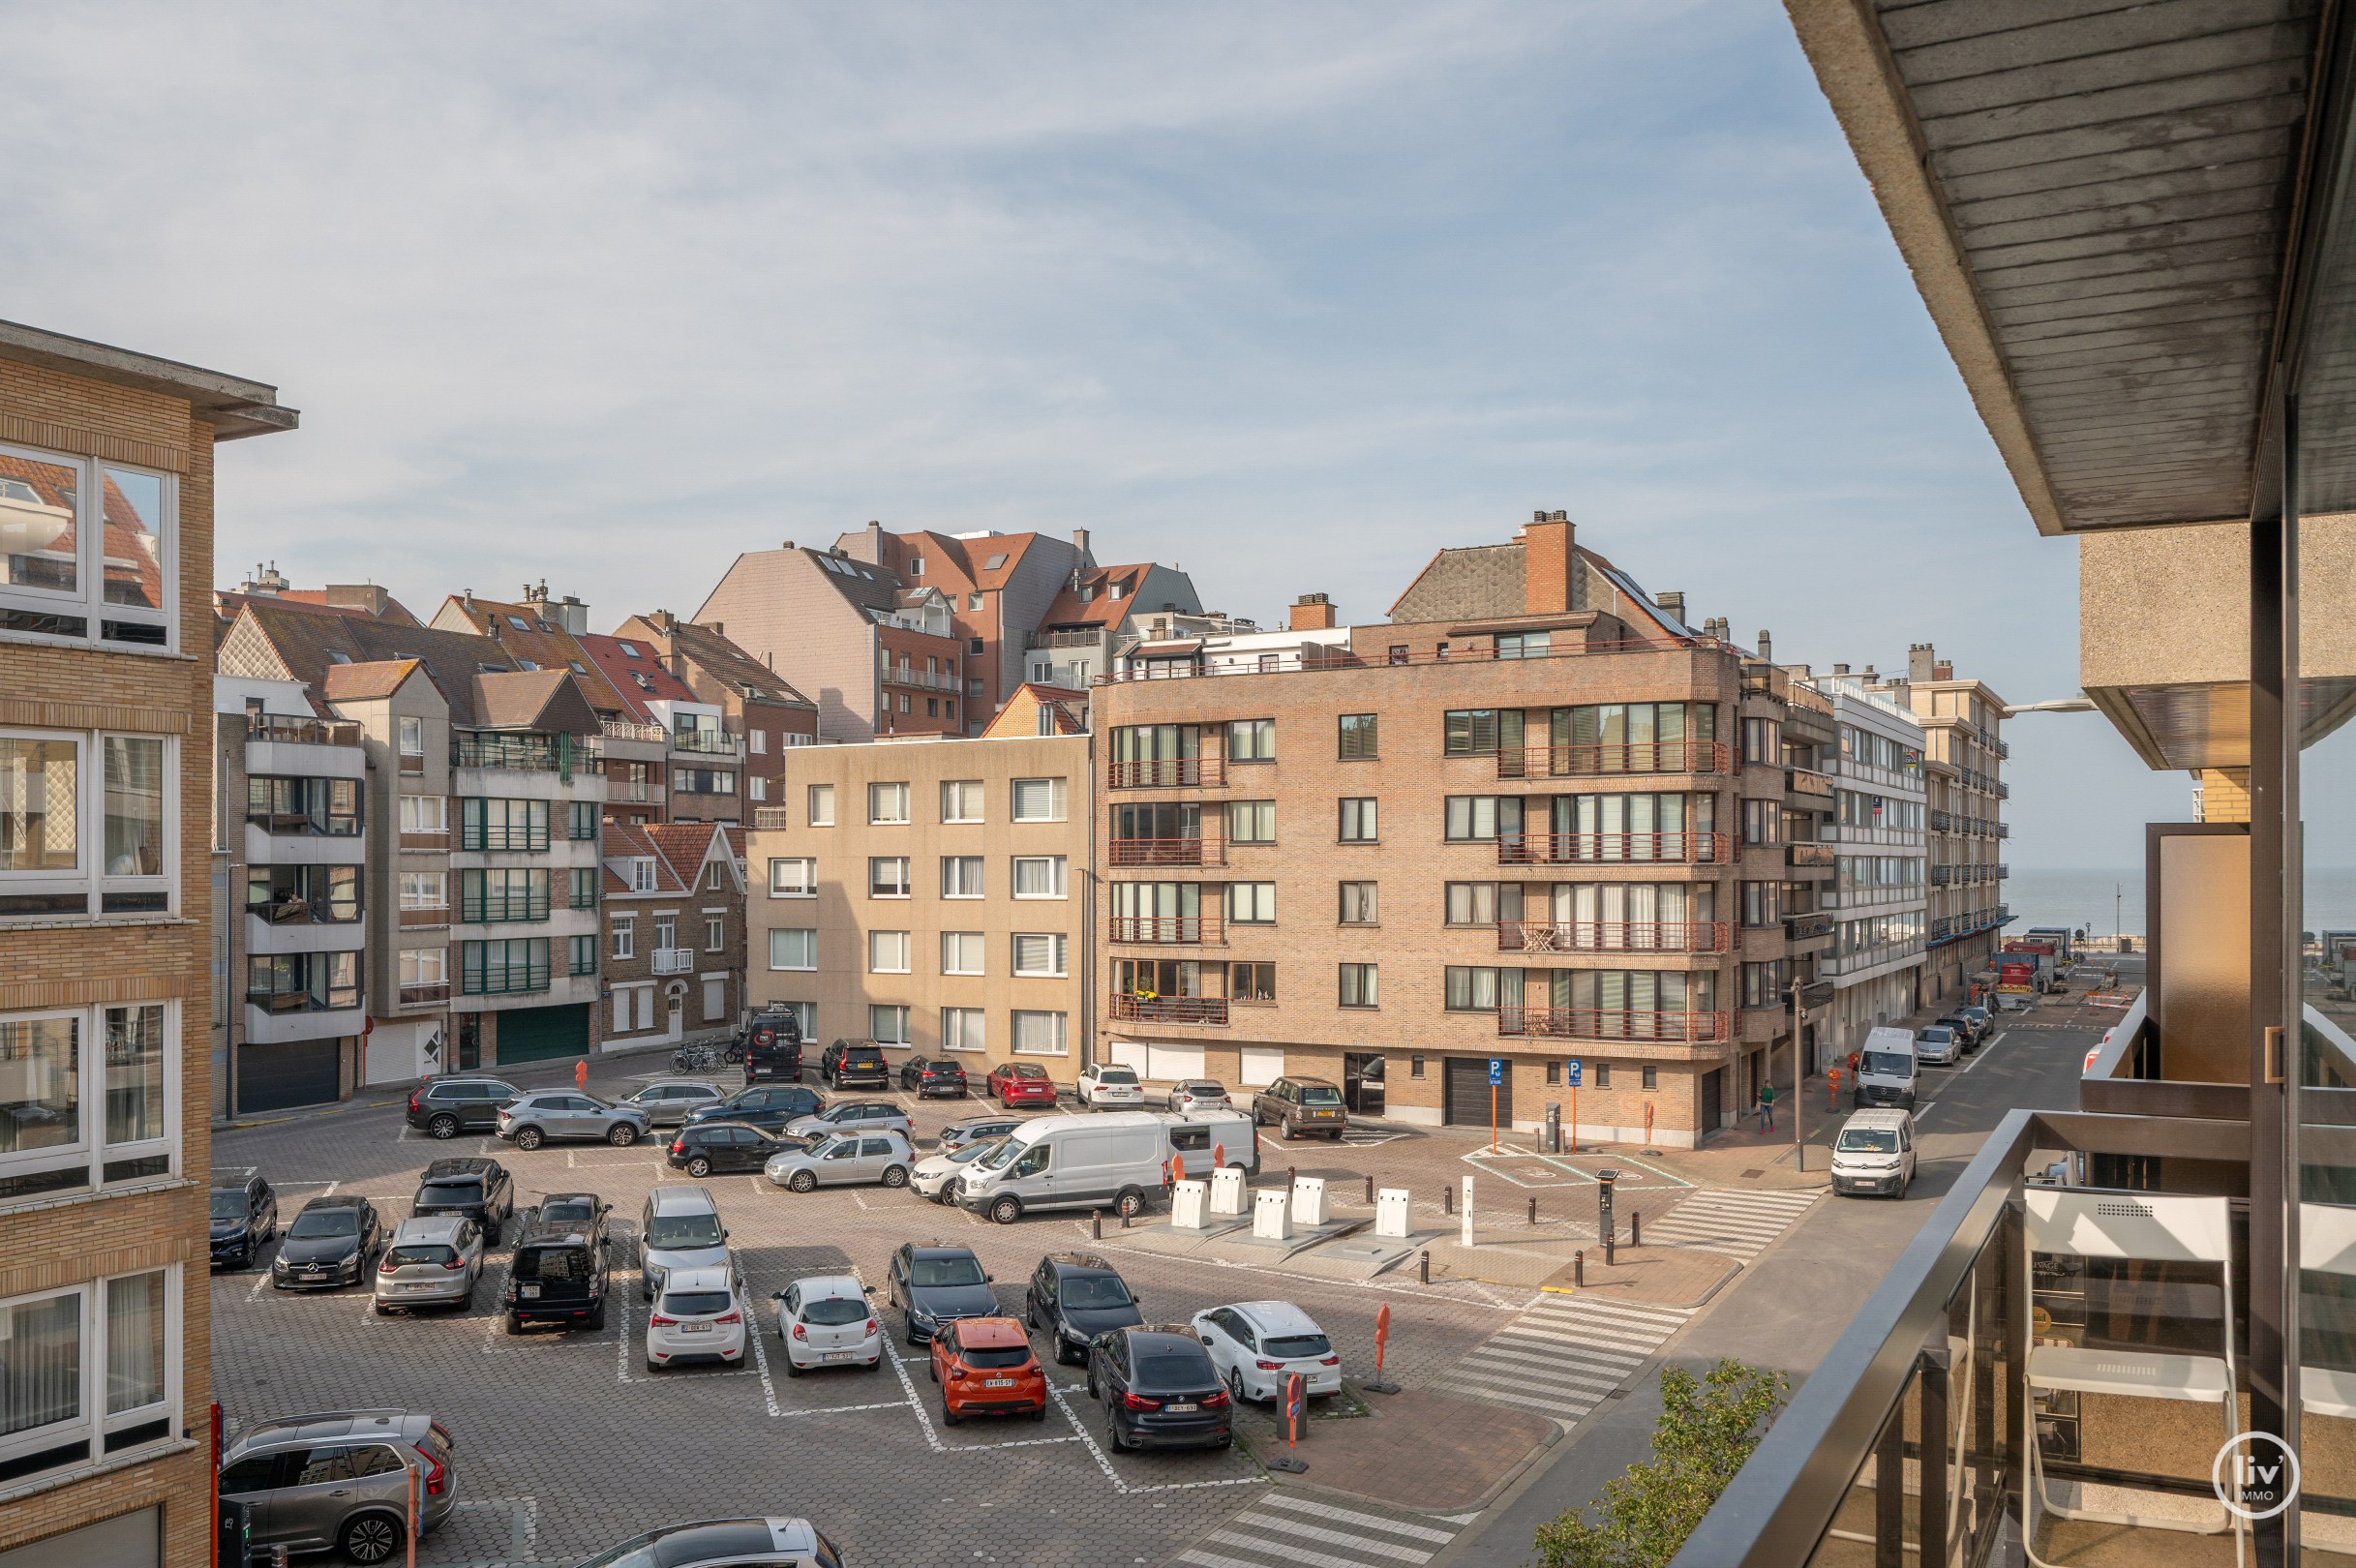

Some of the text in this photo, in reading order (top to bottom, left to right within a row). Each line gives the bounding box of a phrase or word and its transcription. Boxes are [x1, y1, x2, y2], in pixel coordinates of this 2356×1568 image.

[1491, 1061, 1500, 1075] P
[1570, 1062, 1580, 1076] P
[2034, 1261, 2059, 1270] IVAGE
